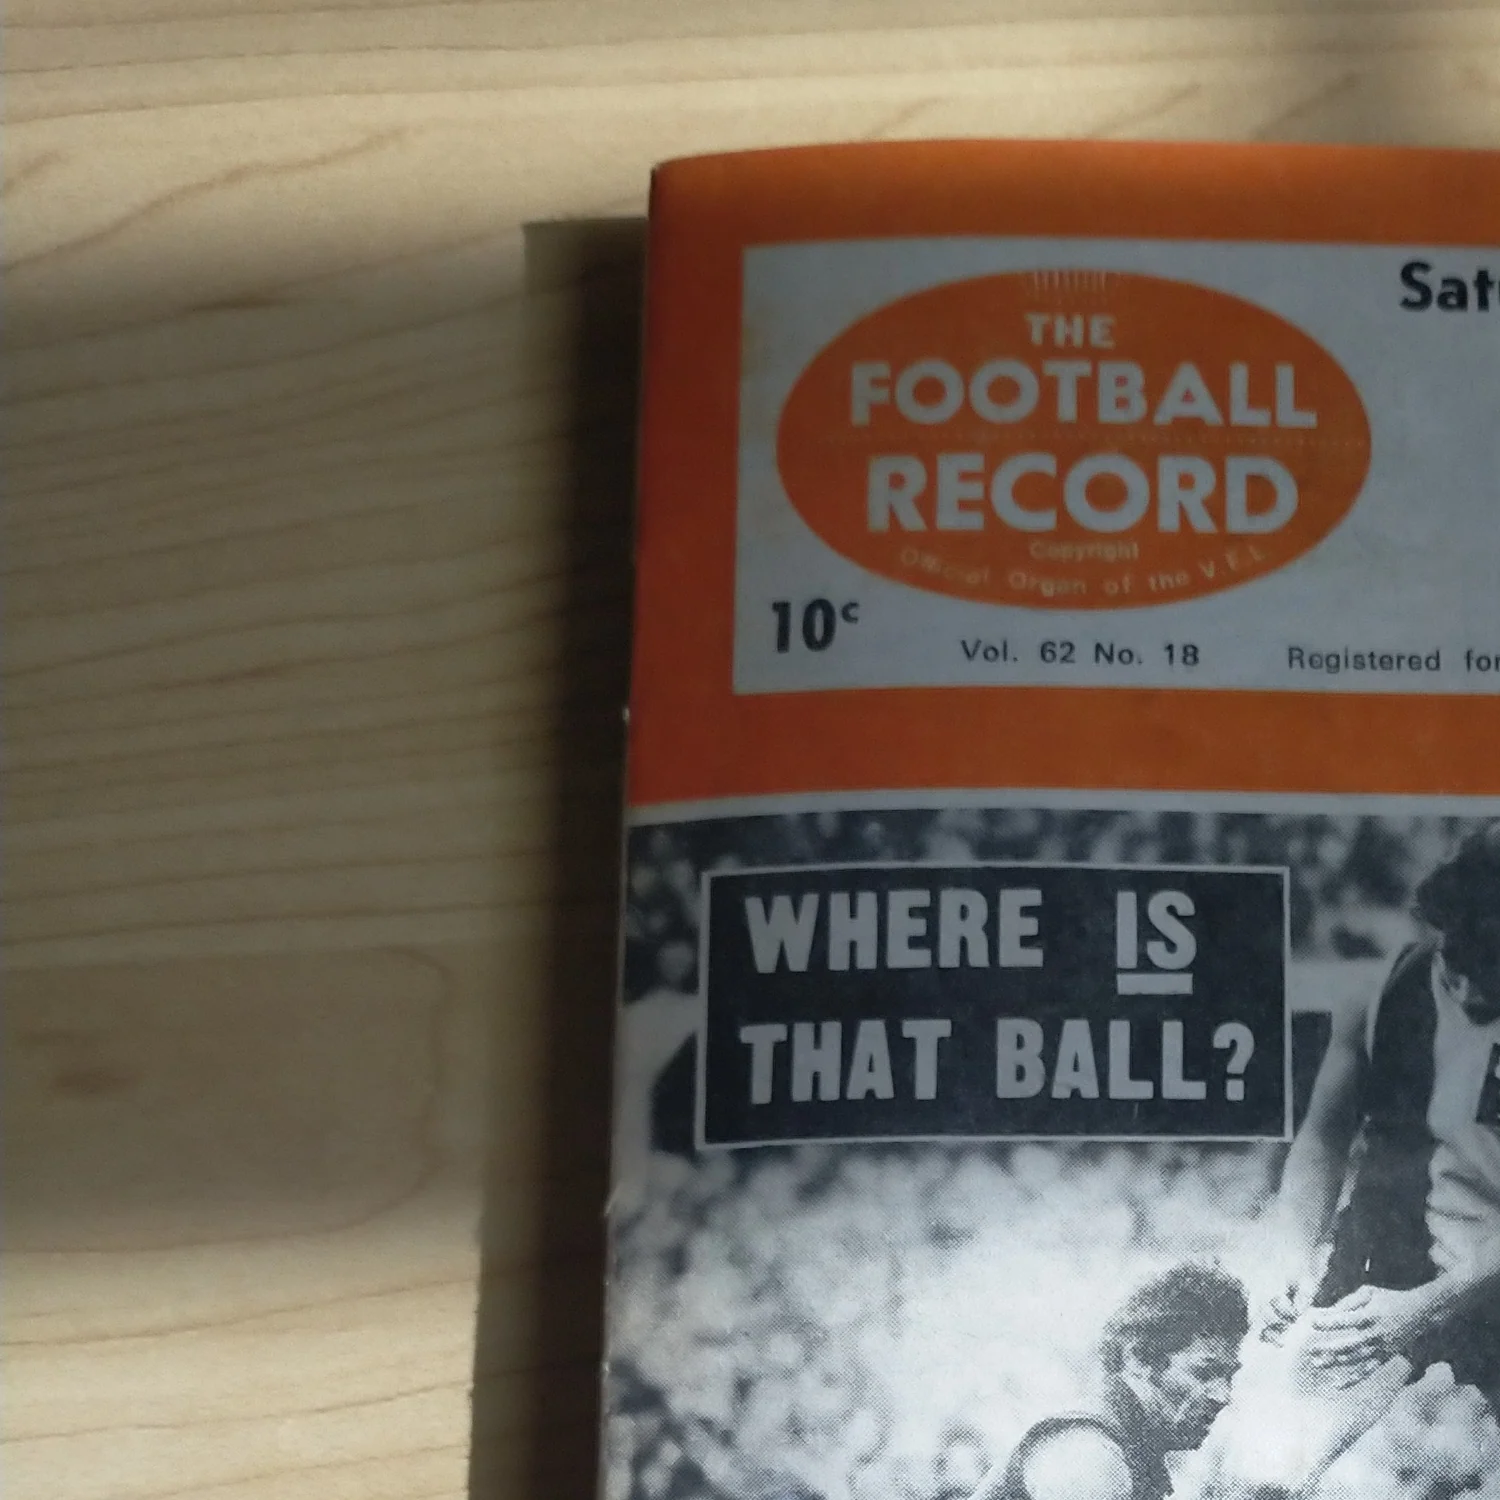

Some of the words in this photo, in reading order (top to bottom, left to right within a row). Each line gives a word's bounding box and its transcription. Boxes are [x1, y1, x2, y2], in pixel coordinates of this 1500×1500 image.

[1024, 312, 1115, 348] THE
[850, 358, 1318, 429] FOOTBALL
[867, 452, 1299, 534] RECORD
[1030, 542, 1140, 562] Copyright
[1104, 573, 1132, 593] of
[1147, 570, 1189, 590] the
[959, 637, 1019, 663] Vol.
[1038, 639, 1076, 664] 62
[1093, 641, 1144, 666] No.
[1162, 641, 1201, 668] 18
[1286, 644, 1442, 675] Registered
[744, 887, 1044, 974] WHERE
[1115, 889, 1197, 970] IS
[738, 1018, 953, 1105] THAT
[995, 1016, 1255, 1101] BALL?
